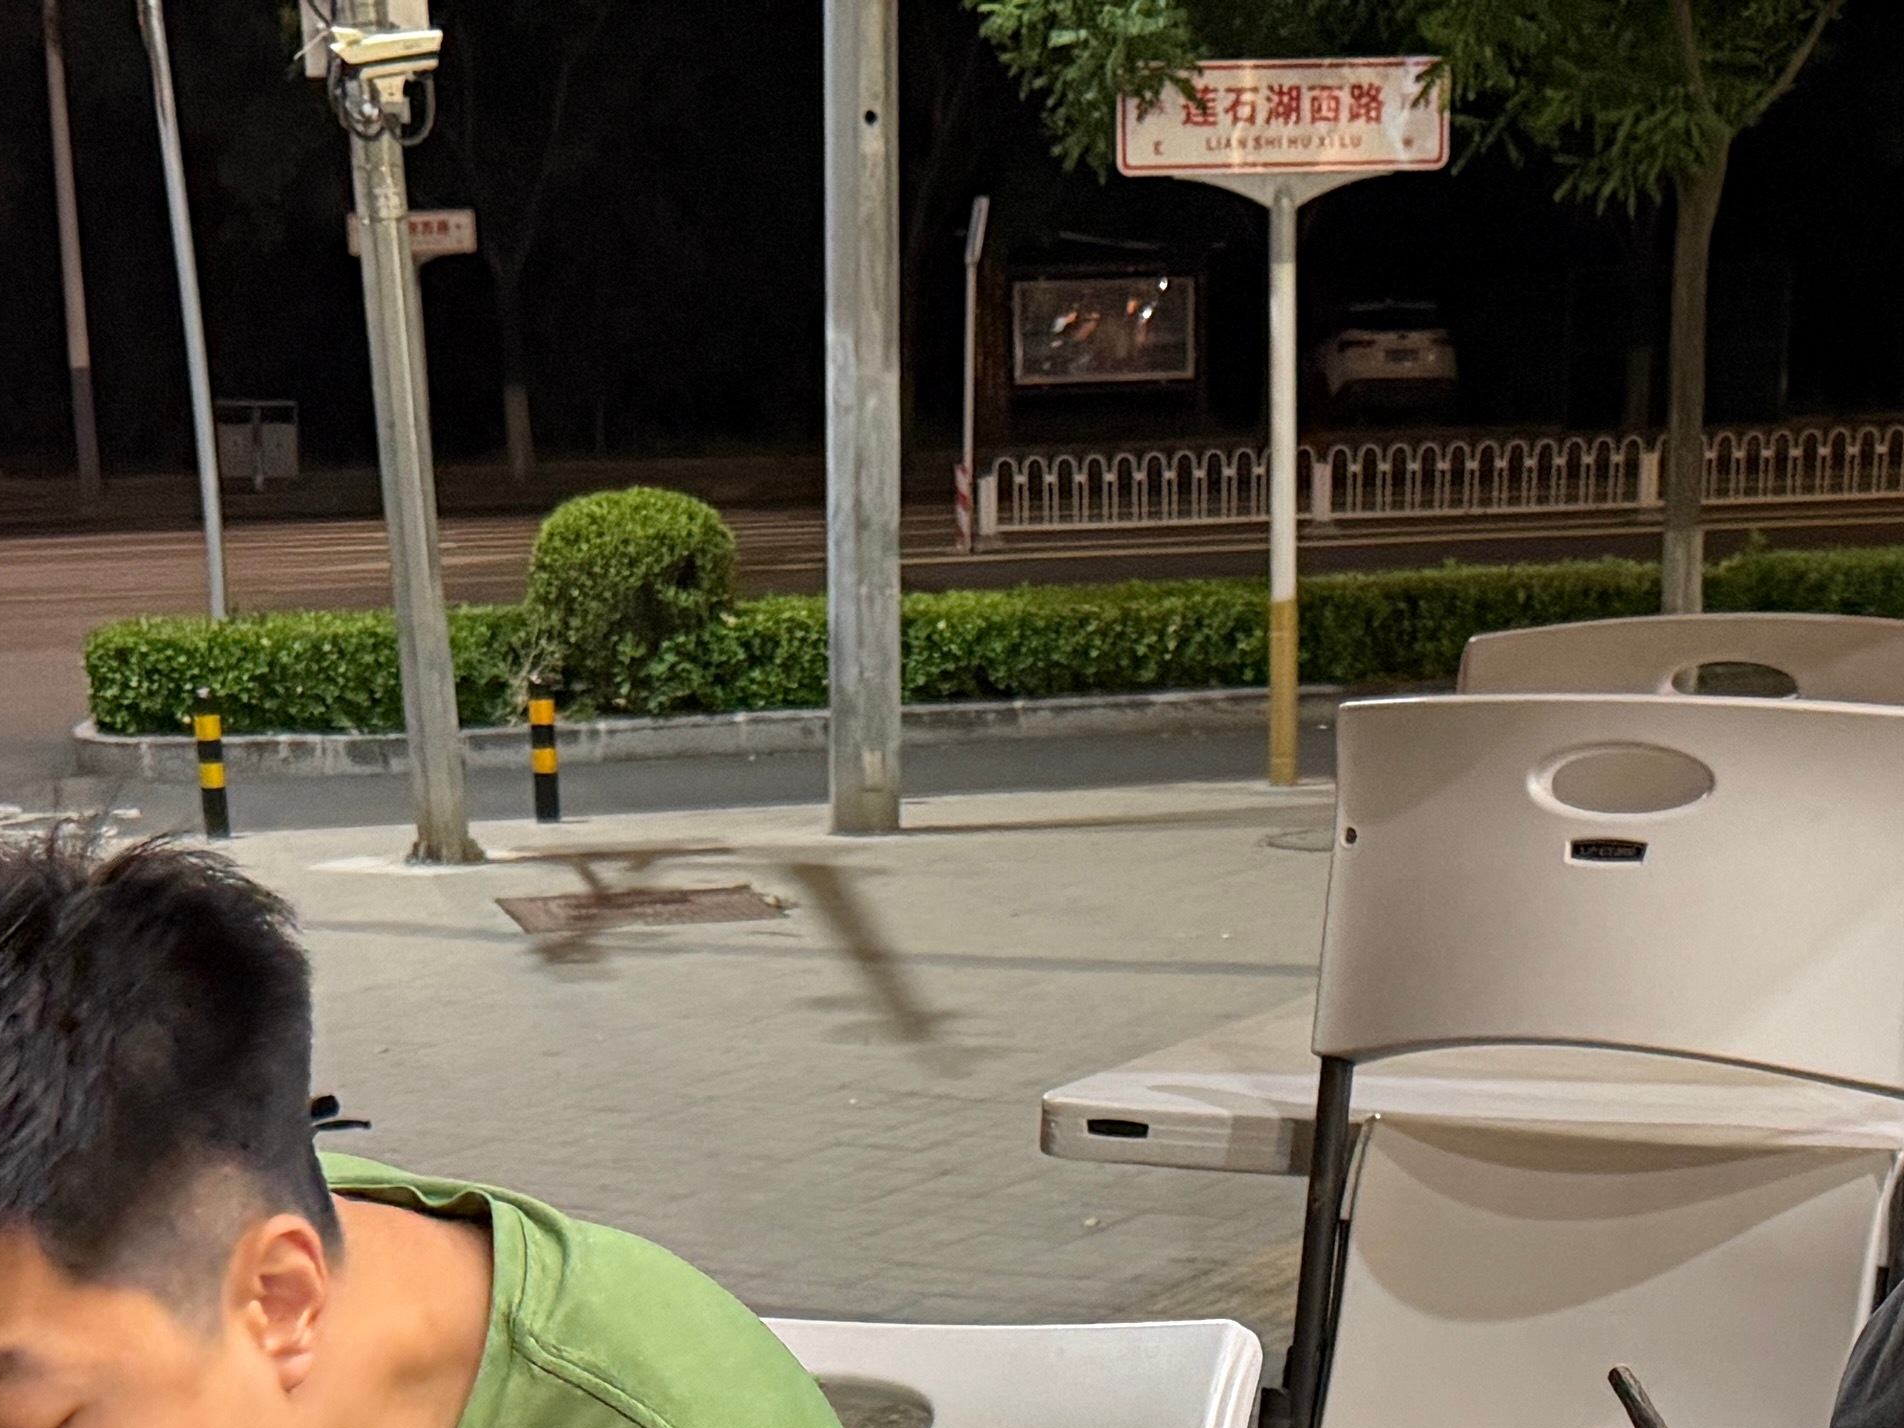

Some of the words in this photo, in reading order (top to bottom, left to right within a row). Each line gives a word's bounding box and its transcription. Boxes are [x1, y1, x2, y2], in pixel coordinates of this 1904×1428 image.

[1182, 83, 1385, 127] 莲石湖西路
